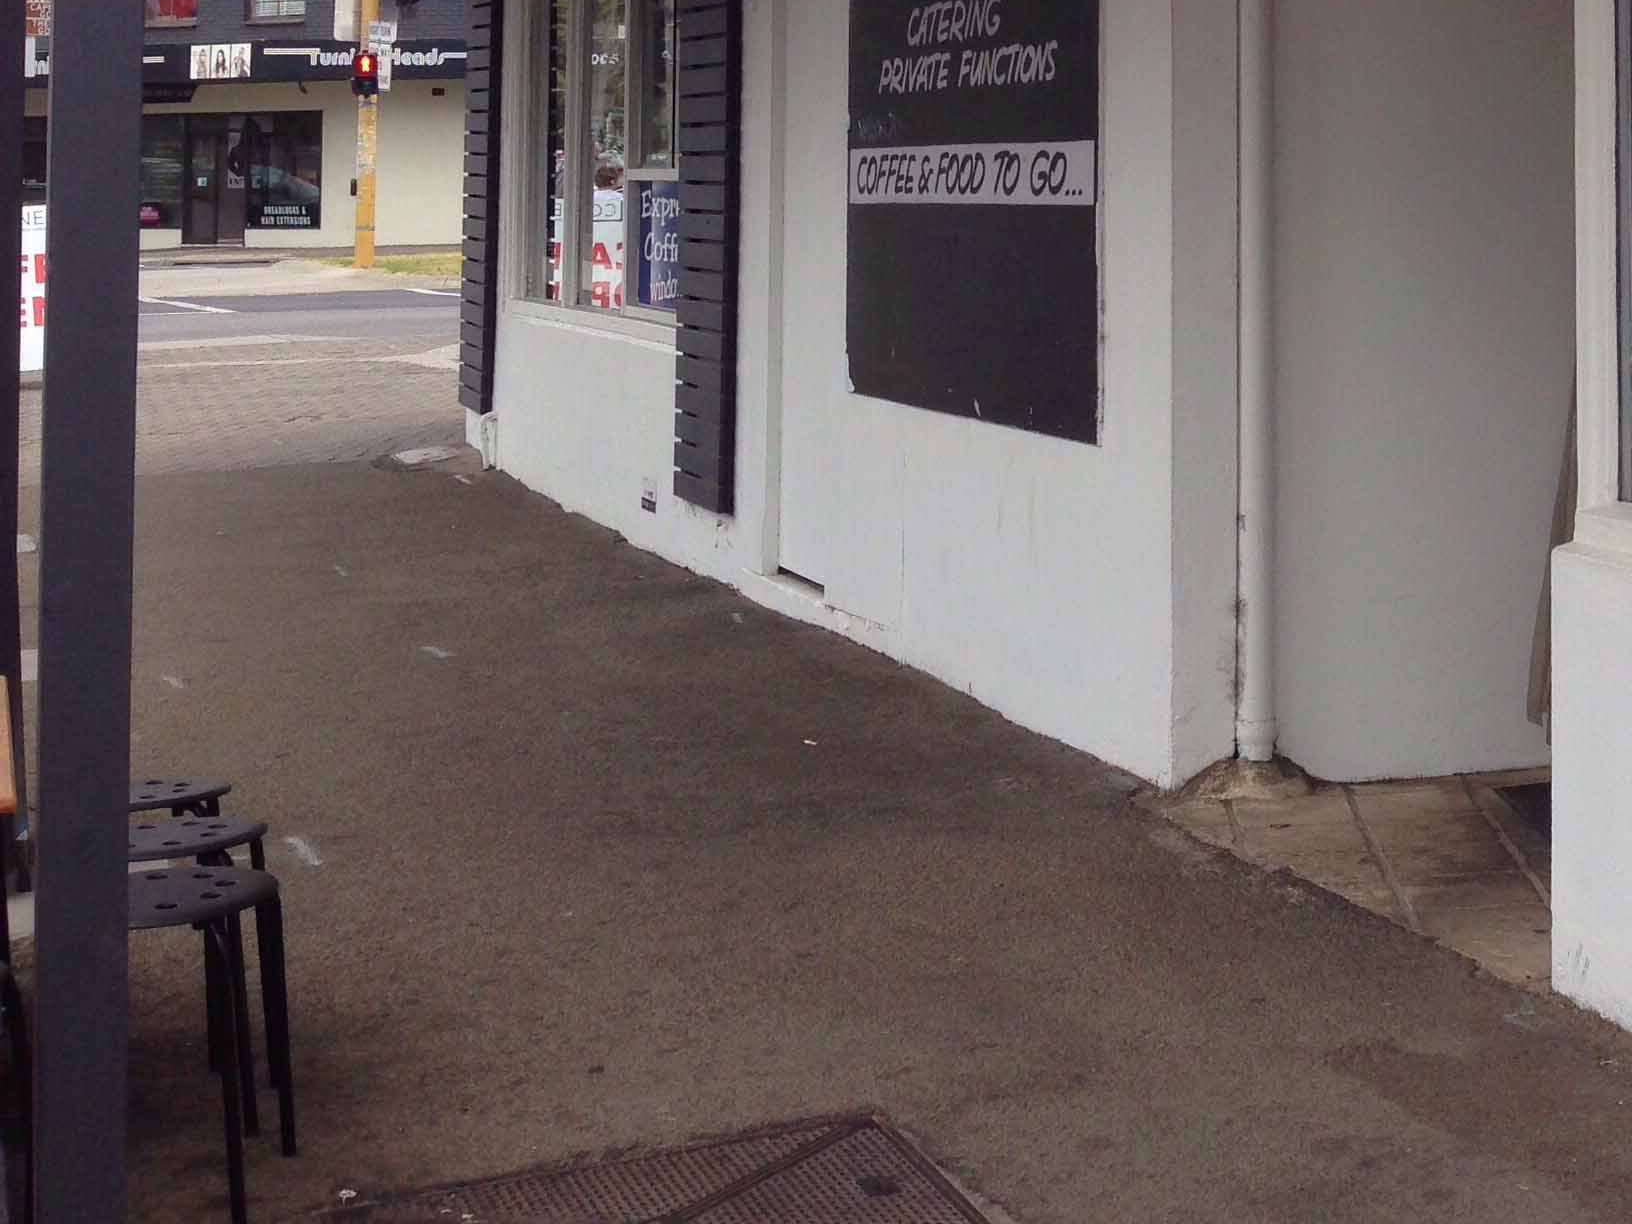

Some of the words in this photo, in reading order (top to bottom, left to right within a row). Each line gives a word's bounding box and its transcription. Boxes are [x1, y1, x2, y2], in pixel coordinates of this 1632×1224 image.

[310, 47, 355, 66] Turni
[878, 51, 950, 95] PRIVATE
[958, 40, 1059, 88] FUNCTIONS
[857, 154, 916, 196] COFFEE
[917, 157, 934, 195] &
[935, 151, 985, 195] FOOD
[992, 150, 1020, 197] TO
[650, 271, 680, 303] windo
